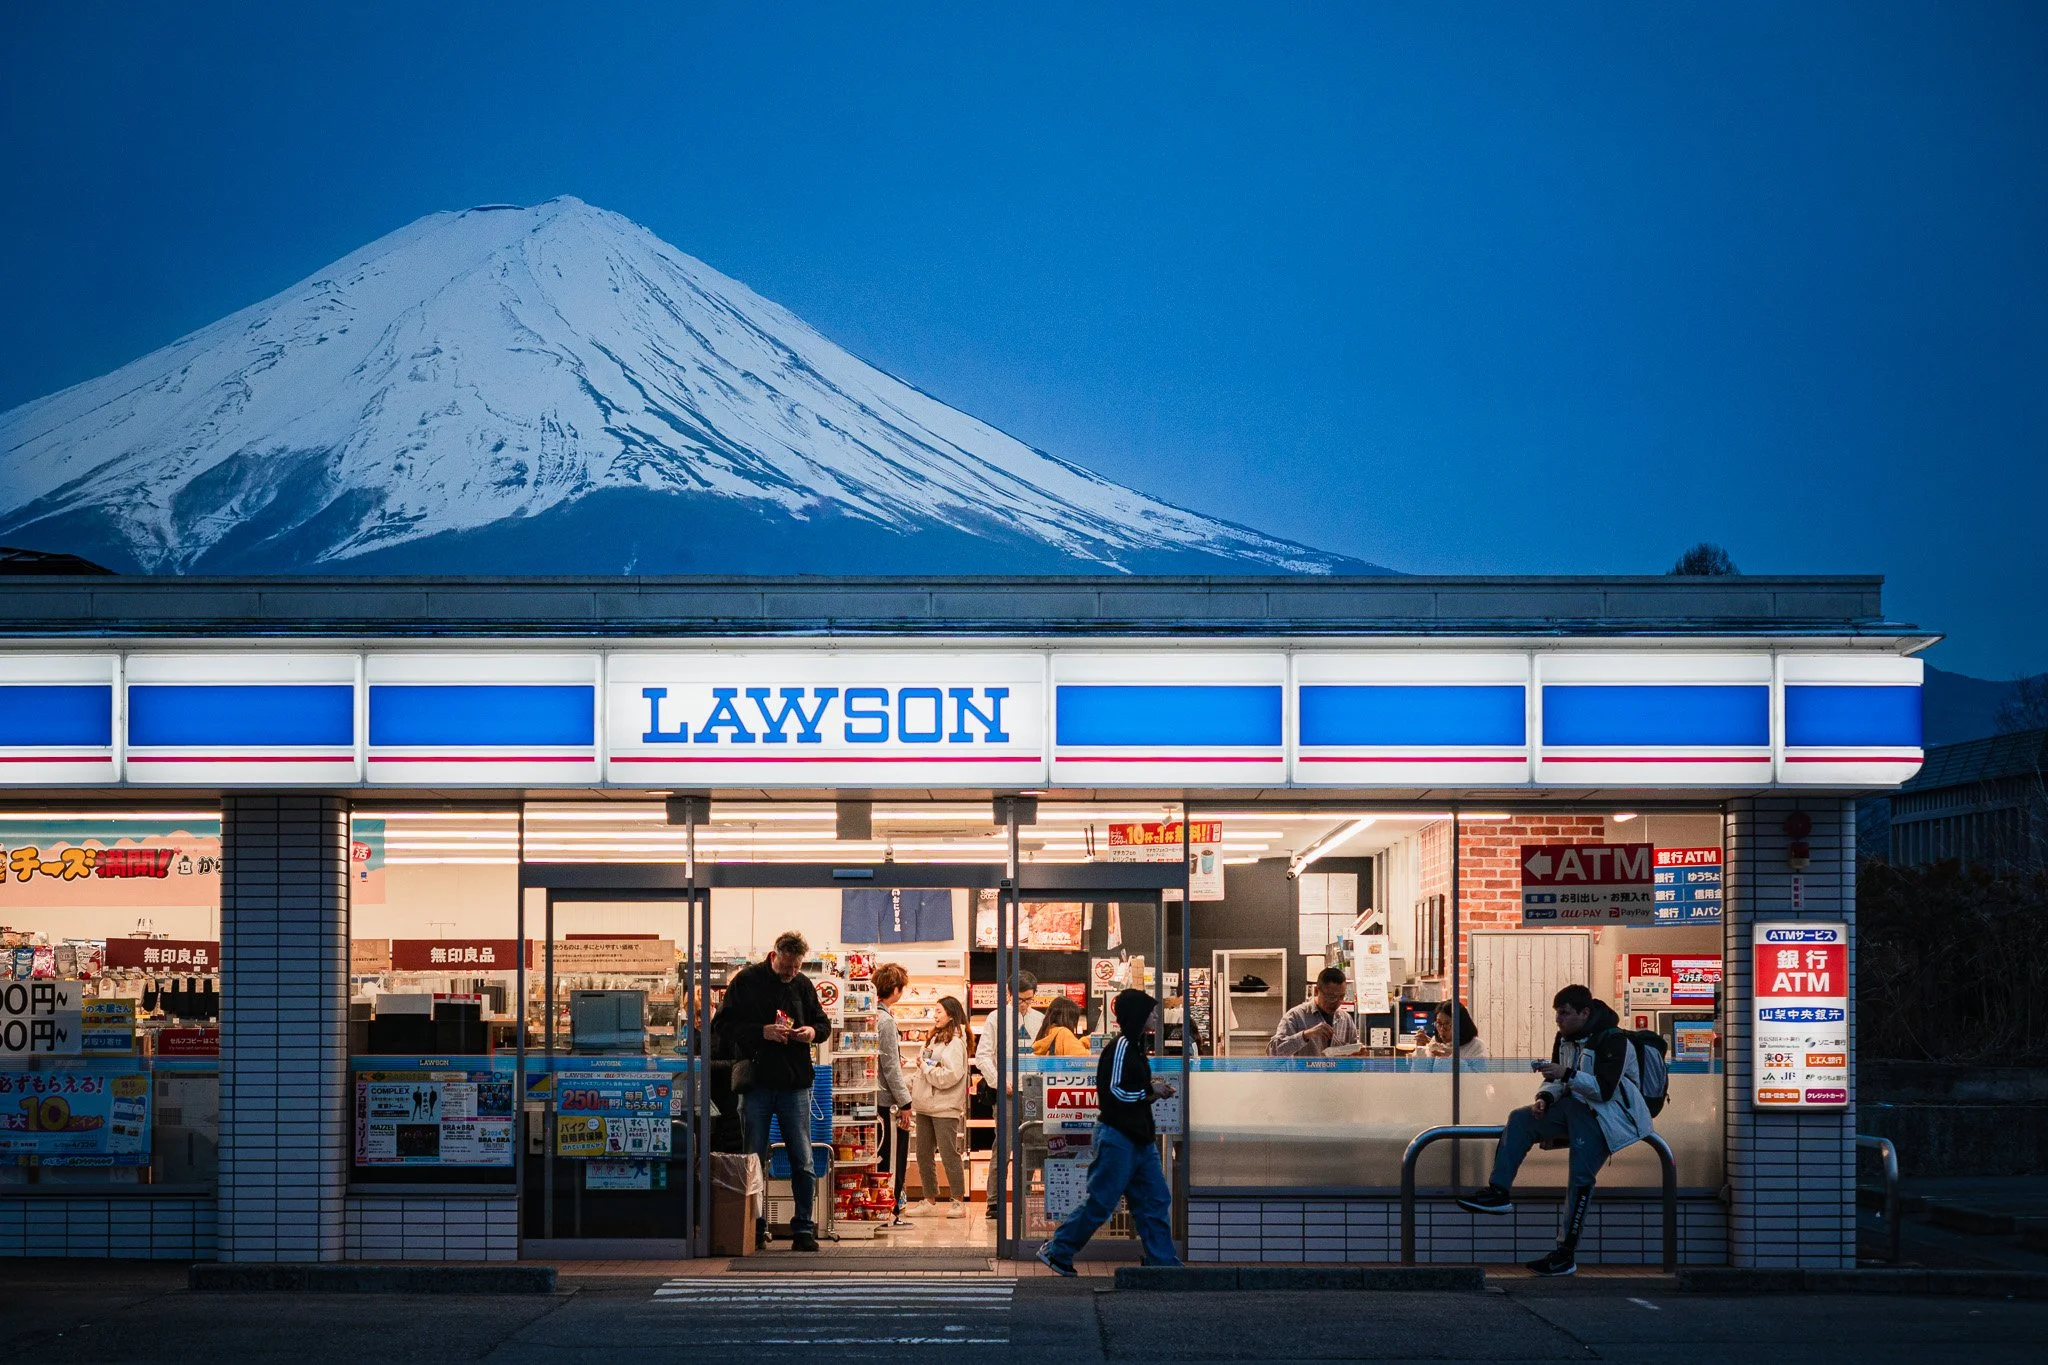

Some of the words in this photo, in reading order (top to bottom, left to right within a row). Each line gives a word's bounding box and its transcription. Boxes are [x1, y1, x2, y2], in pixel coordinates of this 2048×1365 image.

[642, 687, 1010, 743] LAWSON
[353, 846, 369, 860] 活
[1657, 850, 1717, 864] 銀行ATM
[0, 846, 174, 884] チーズ満開!
[1554, 847, 1650, 881] ATM
[1687, 871, 1721, 882] ゆうちょ
[1560, 892, 1650, 903] お引出し・お預入れ
[1583, 909, 1602, 918] PAY
[1621, 908, 1650, 918] PayPay
[1769, 931, 1834, 941] ATMサービス
[144, 947, 209, 965] 無印良品
[430, 947, 496, 963] 無印良品
[1776, 949, 1829, 970] 銀行
[1771, 972, 1830, 993] ATM
[0, 984, 68, 1015] 0円~
[82, 1003, 132, 1013] の本屋さん
[1761, 1009, 1842, 1021] 山梨中央銀行
[0, 1020, 68, 1051] 0円~
[1809, 1056, 1843, 1064] じぶん銀行
[0, 1075, 104, 1093] 必ずもらえる!
[371, 1087, 410, 1095] COMPLEX
[1057, 1091, 1099, 1106] ATM
[560, 1122, 586, 1133] バイク
